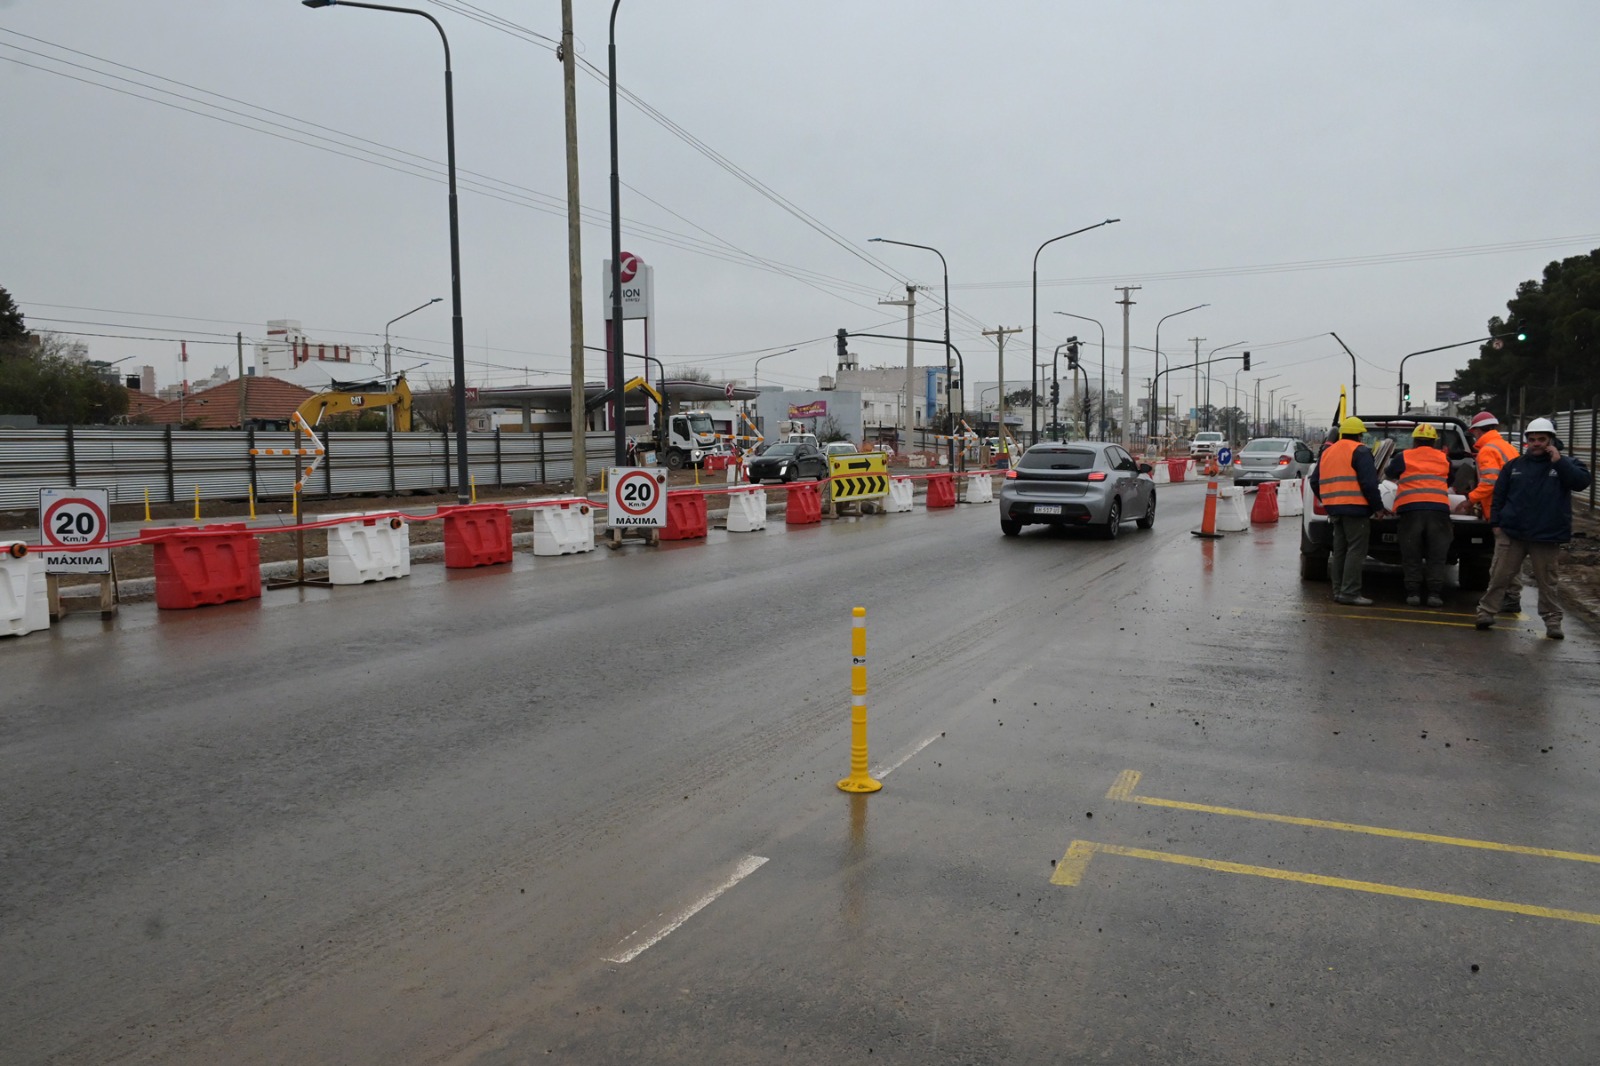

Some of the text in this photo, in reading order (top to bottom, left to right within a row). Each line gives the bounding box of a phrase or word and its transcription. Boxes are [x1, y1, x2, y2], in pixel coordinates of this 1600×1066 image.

[350, 396, 362, 405] CAT
[624, 483, 651, 501] 20
[55, 512, 95, 535] 20
[616, 515, 658, 525] MÁXIMA
[47, 554, 103, 565] MÁXIMA
